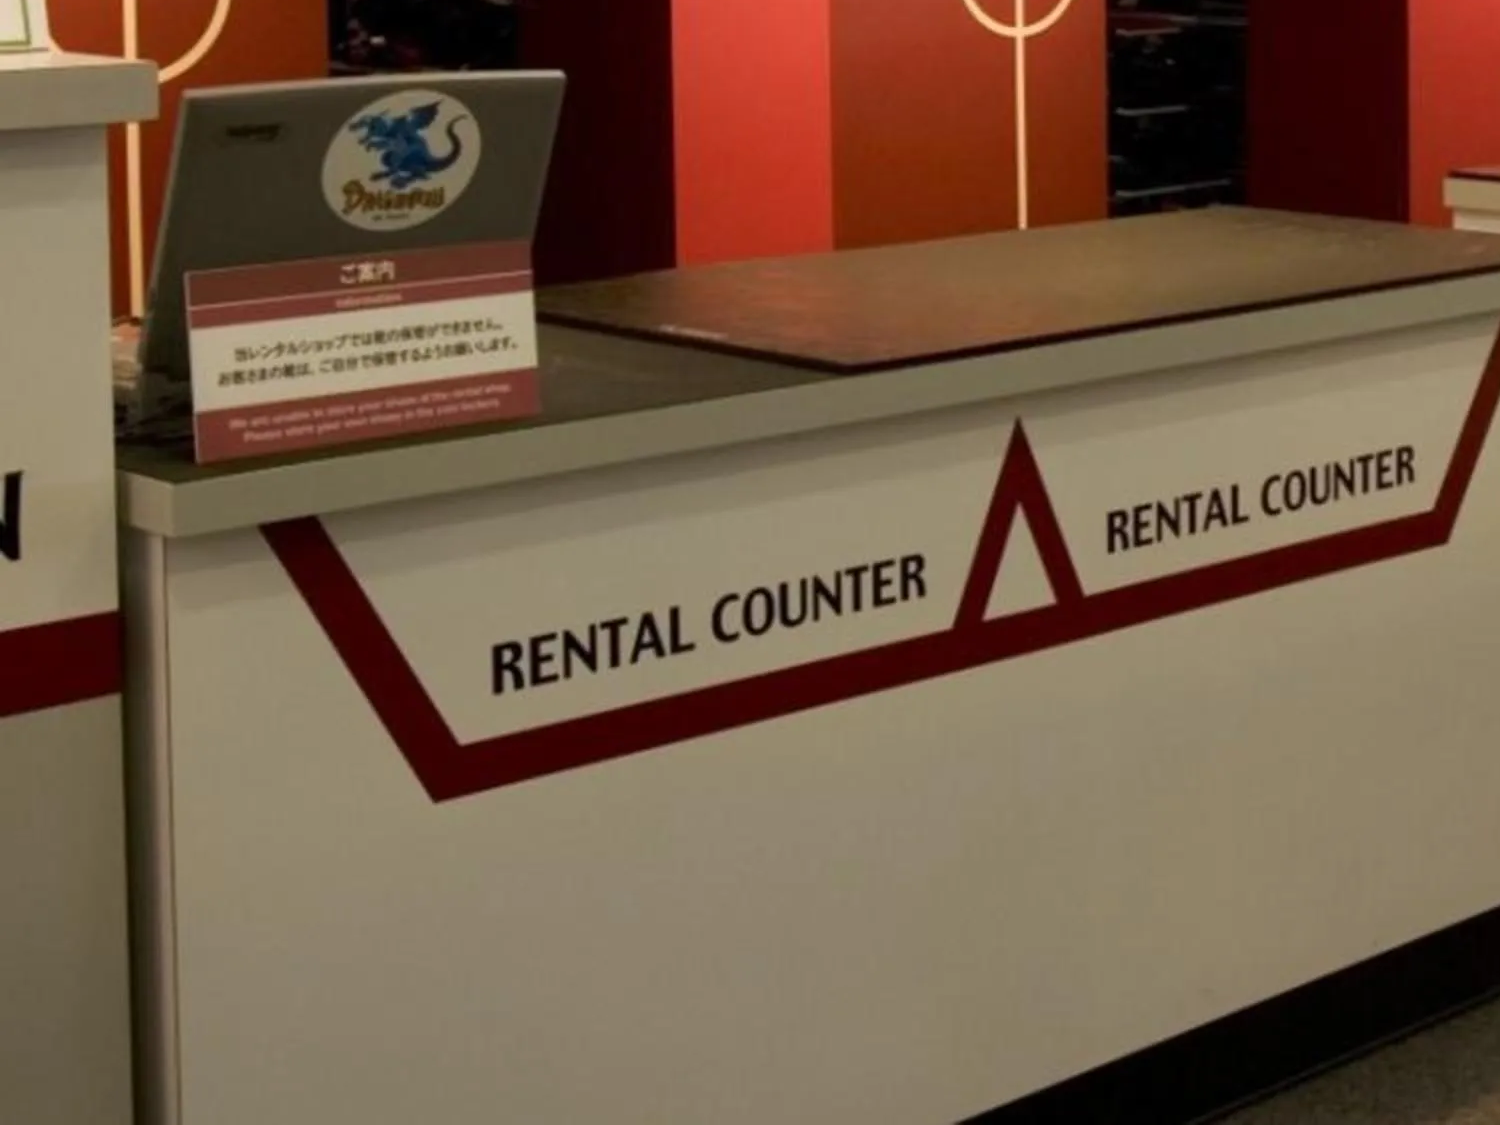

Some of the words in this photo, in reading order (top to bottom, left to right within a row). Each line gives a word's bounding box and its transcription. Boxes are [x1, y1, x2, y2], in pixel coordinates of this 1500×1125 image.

[338, 260, 397, 285] ご案内
[1105, 483, 1250, 557] RENTAL
[1259, 444, 1417, 519] COUNTER
[489, 604, 697, 696] RENTAL
[709, 553, 929, 646] COUNTER
